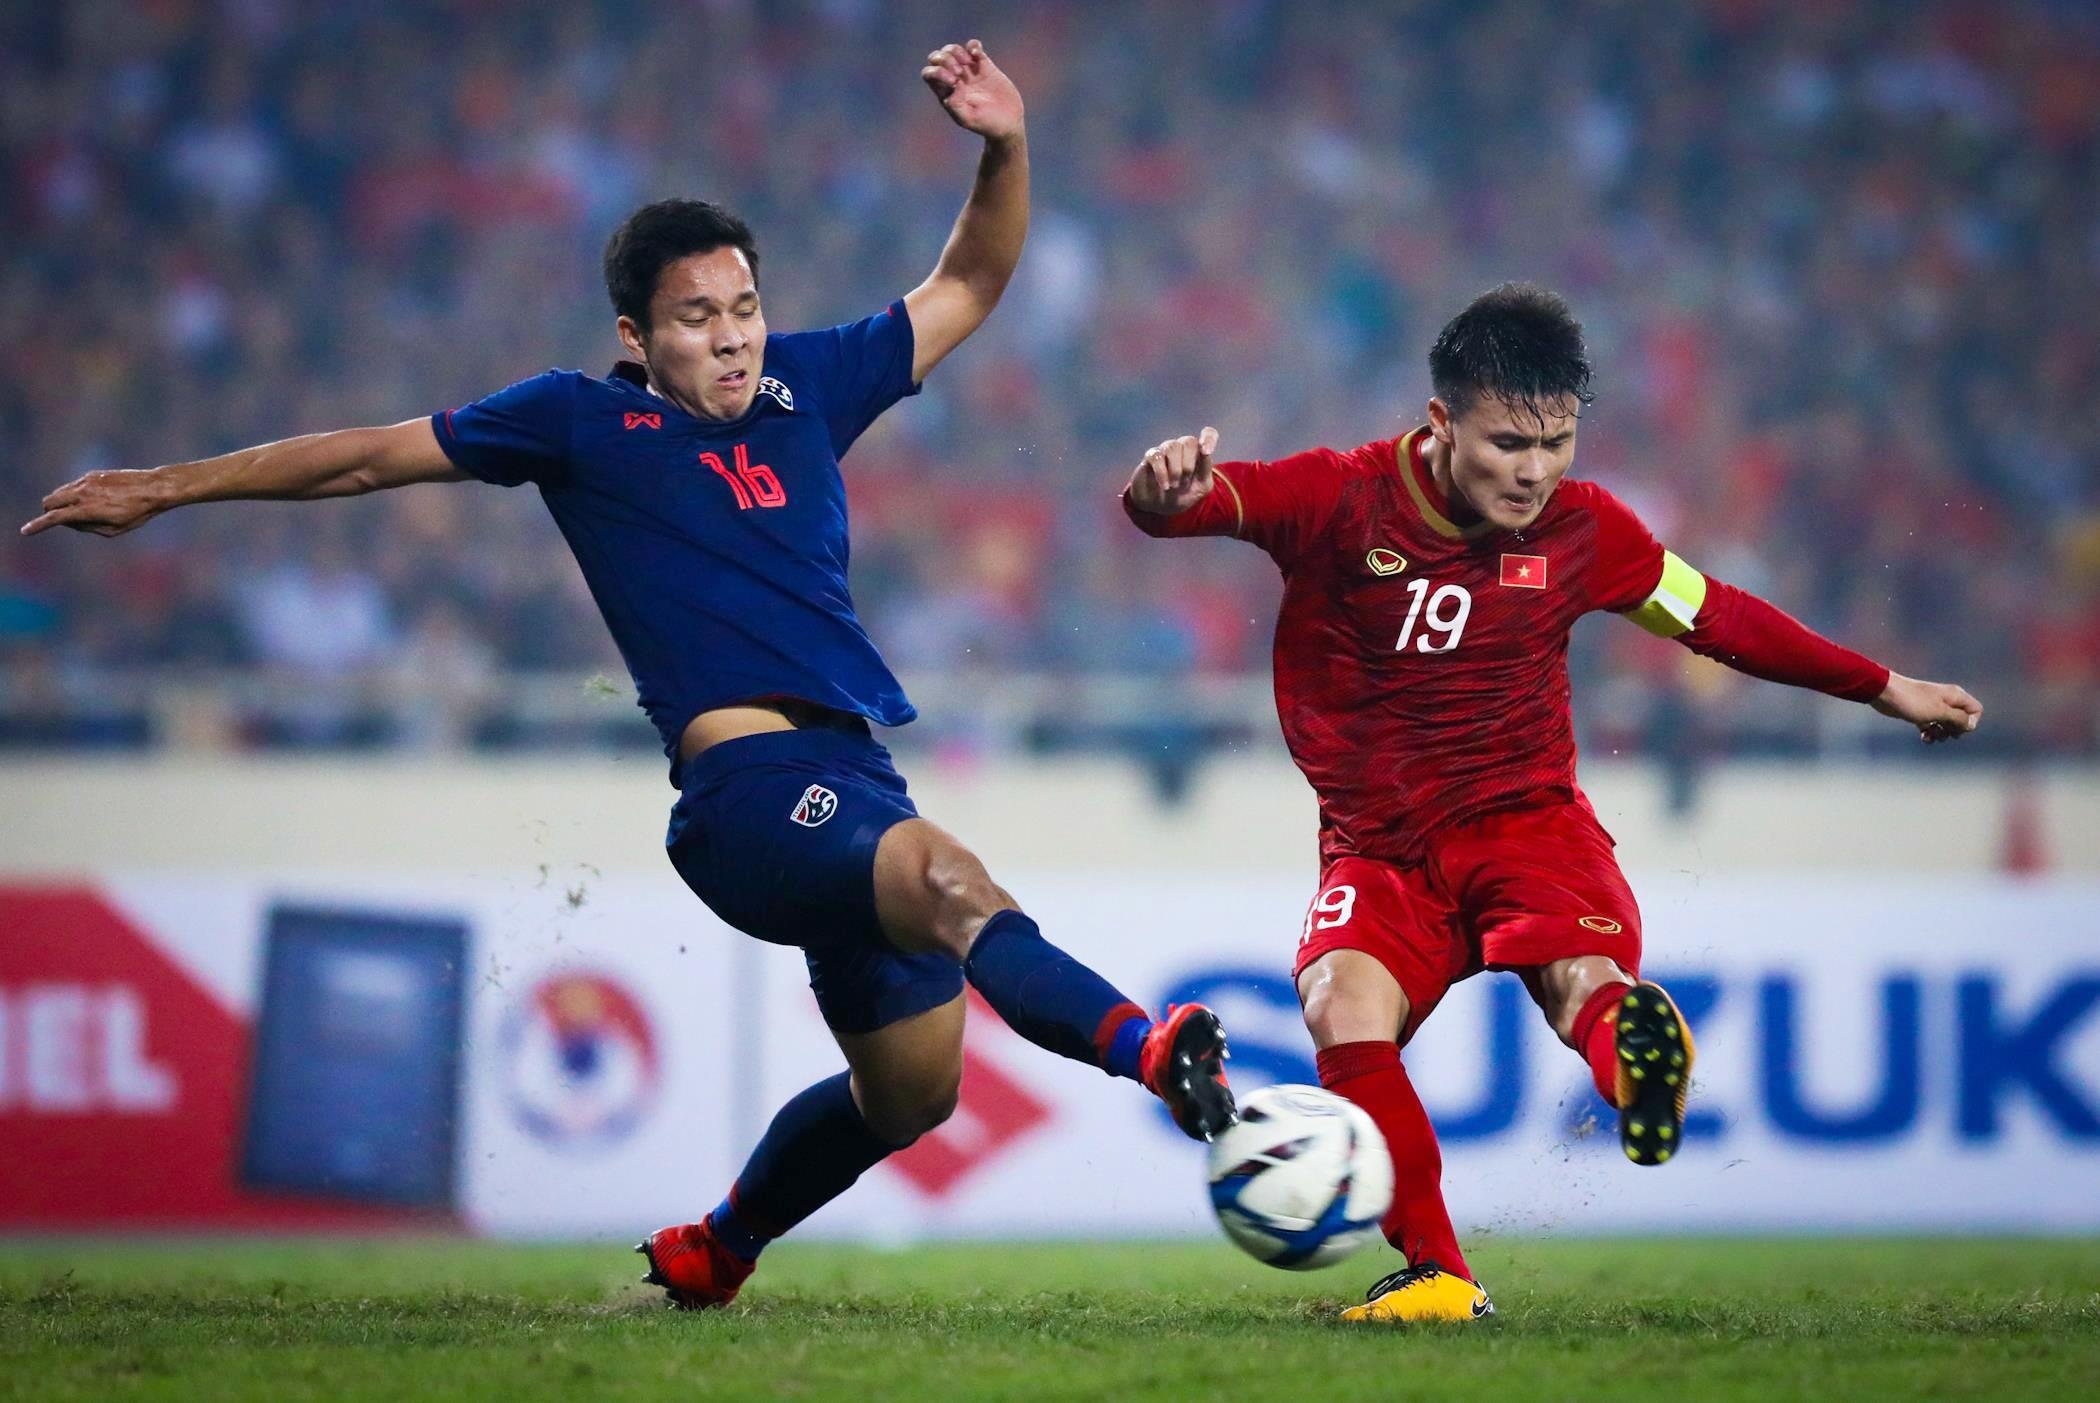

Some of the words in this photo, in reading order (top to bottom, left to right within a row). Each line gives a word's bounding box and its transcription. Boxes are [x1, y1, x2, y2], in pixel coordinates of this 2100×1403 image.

[699, 443, 786, 510] 16
[1395, 578, 1472, 654] 19
[1304, 885, 1357, 945] 19
[0, 982, 177, 1112] EL
